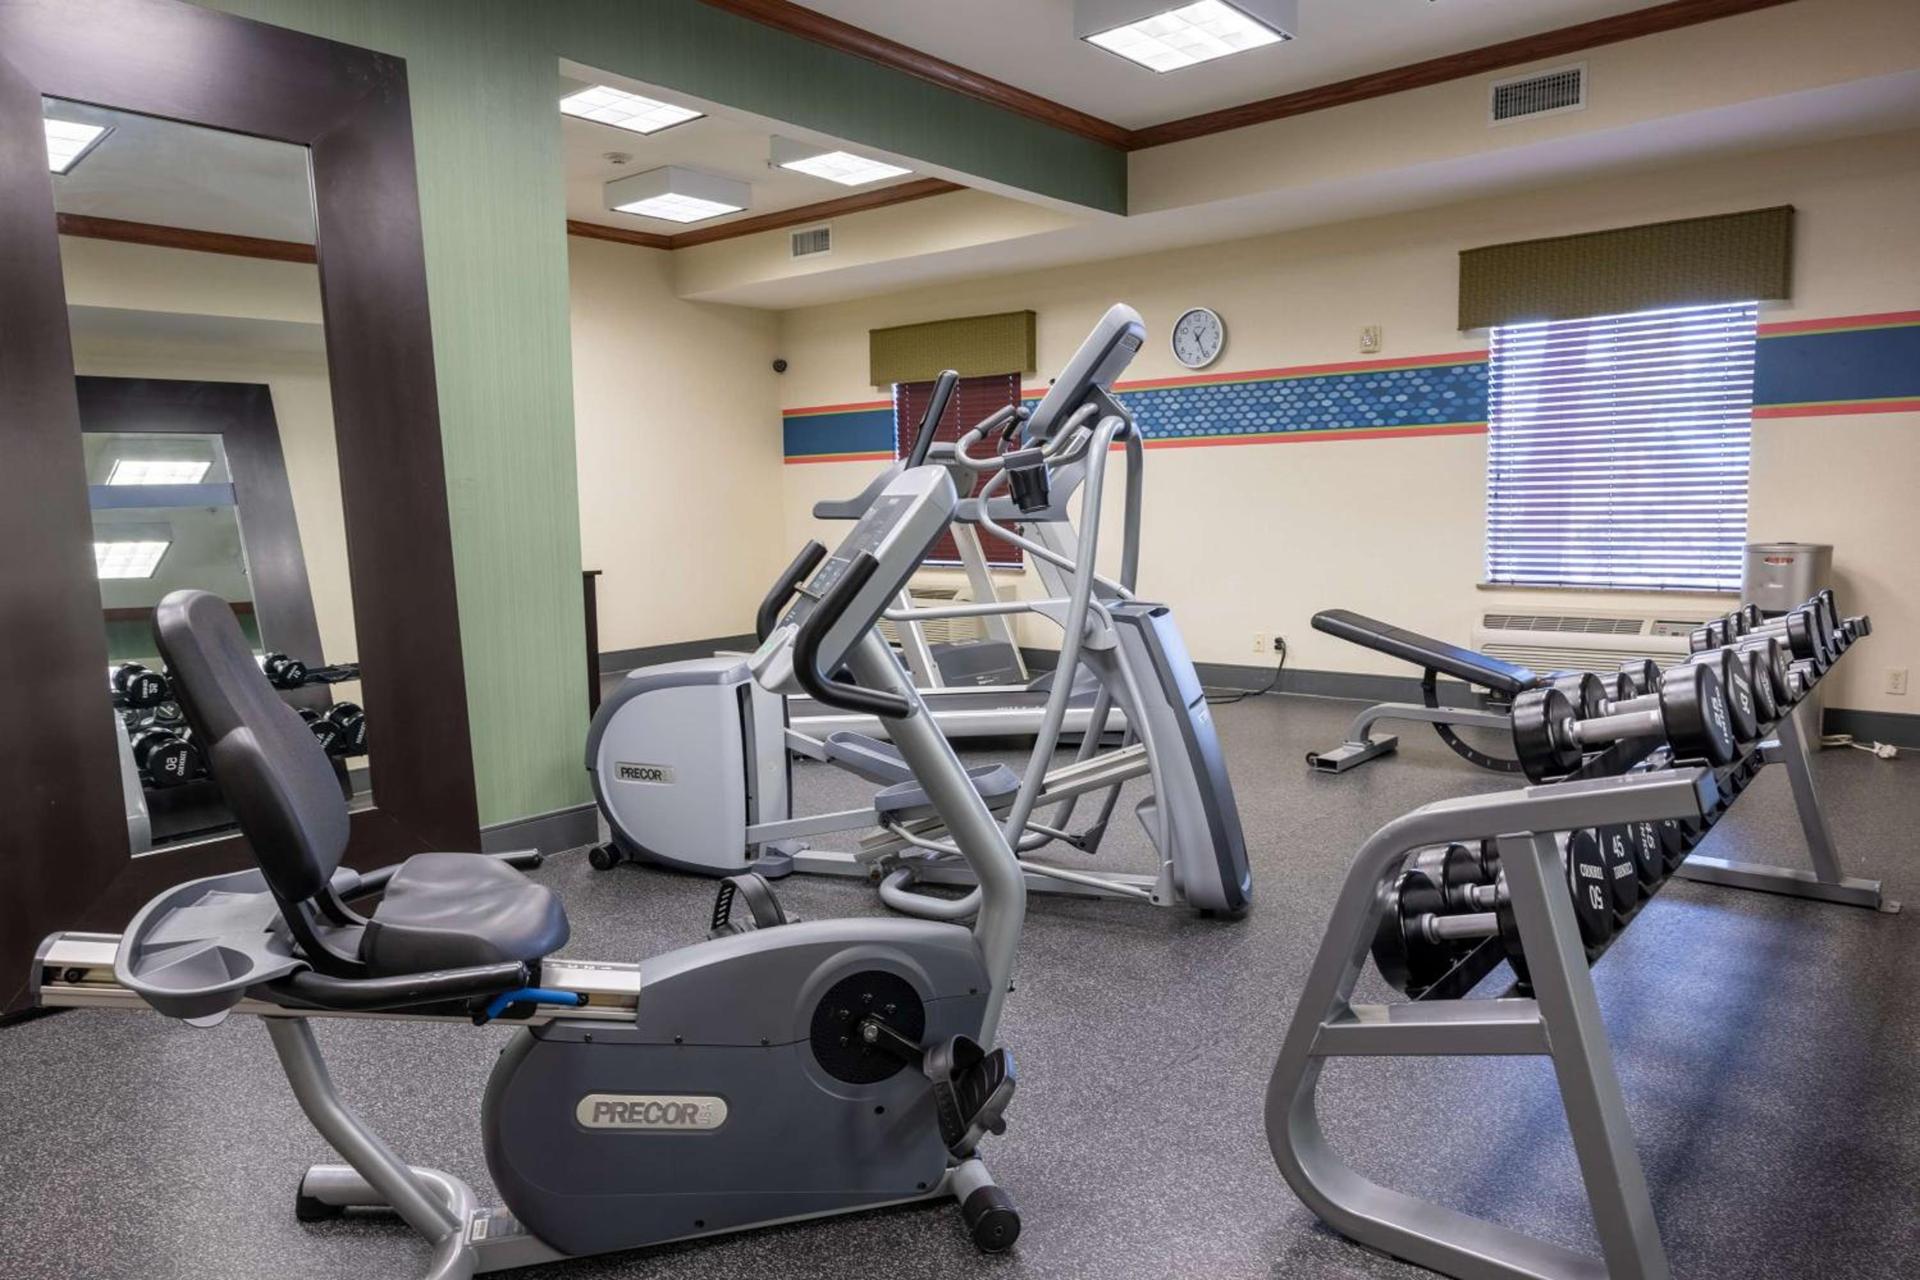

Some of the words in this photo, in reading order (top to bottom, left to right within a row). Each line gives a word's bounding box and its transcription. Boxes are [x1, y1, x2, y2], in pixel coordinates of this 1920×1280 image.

[620, 766, 662, 781] PRECOR
[1612, 835, 1624, 858] 45
[1588, 885, 1604, 910] 50
[592, 1101, 700, 1125] PRECOR
